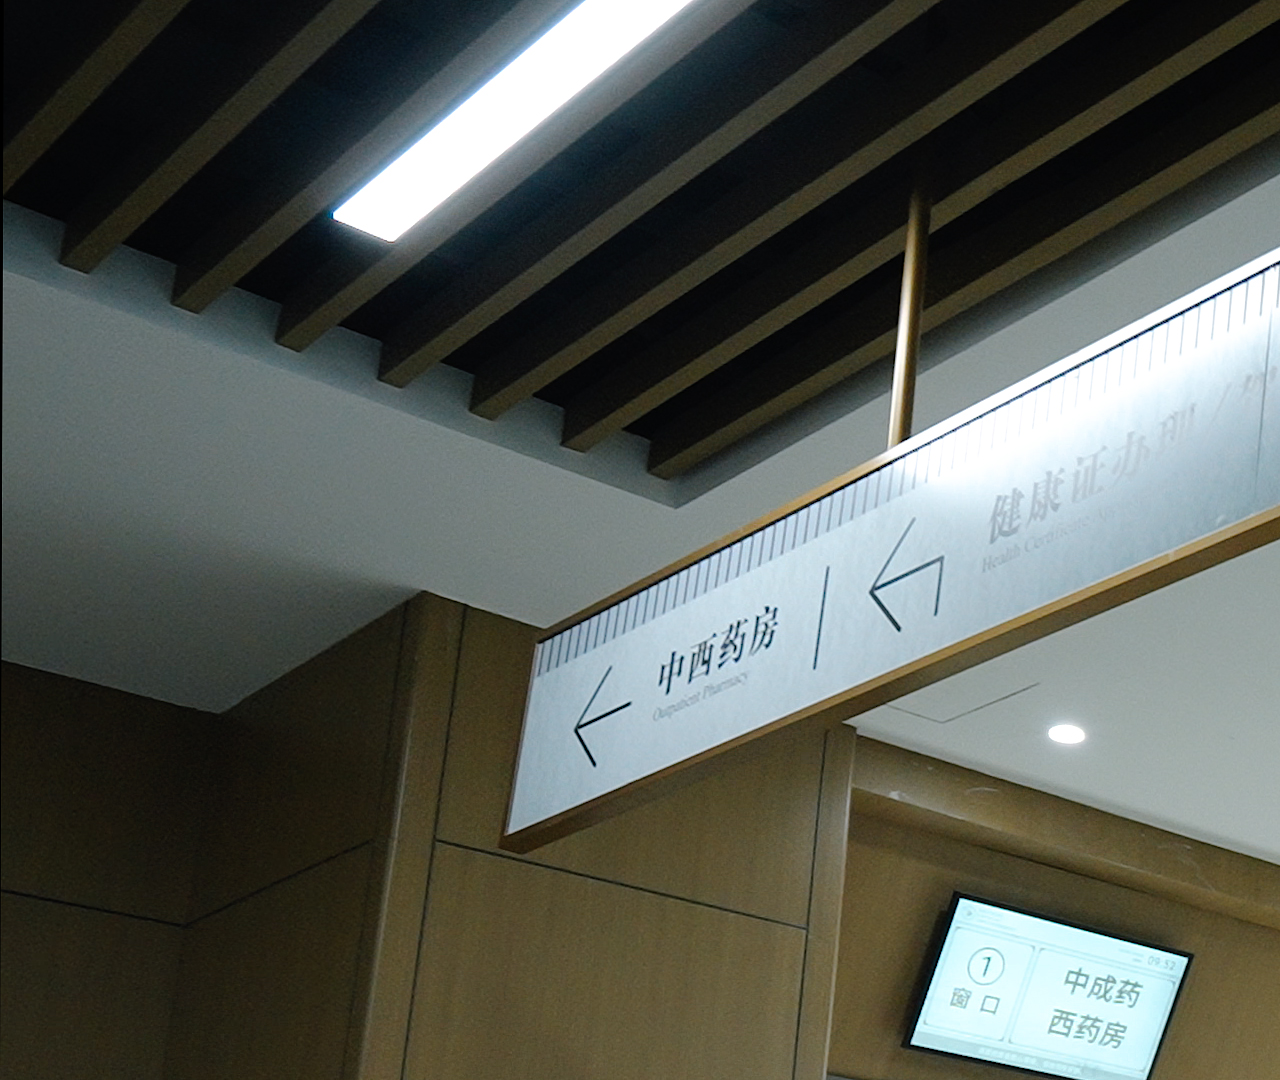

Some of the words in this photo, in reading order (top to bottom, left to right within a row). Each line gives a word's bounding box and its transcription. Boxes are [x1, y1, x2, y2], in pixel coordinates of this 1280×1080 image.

[658, 605, 778, 696] 中西药房
[949, 987, 1000, 1015] 窗口
[1063, 967, 1144, 1009] 中成药
[1047, 1009, 1128, 1049] 西药房
